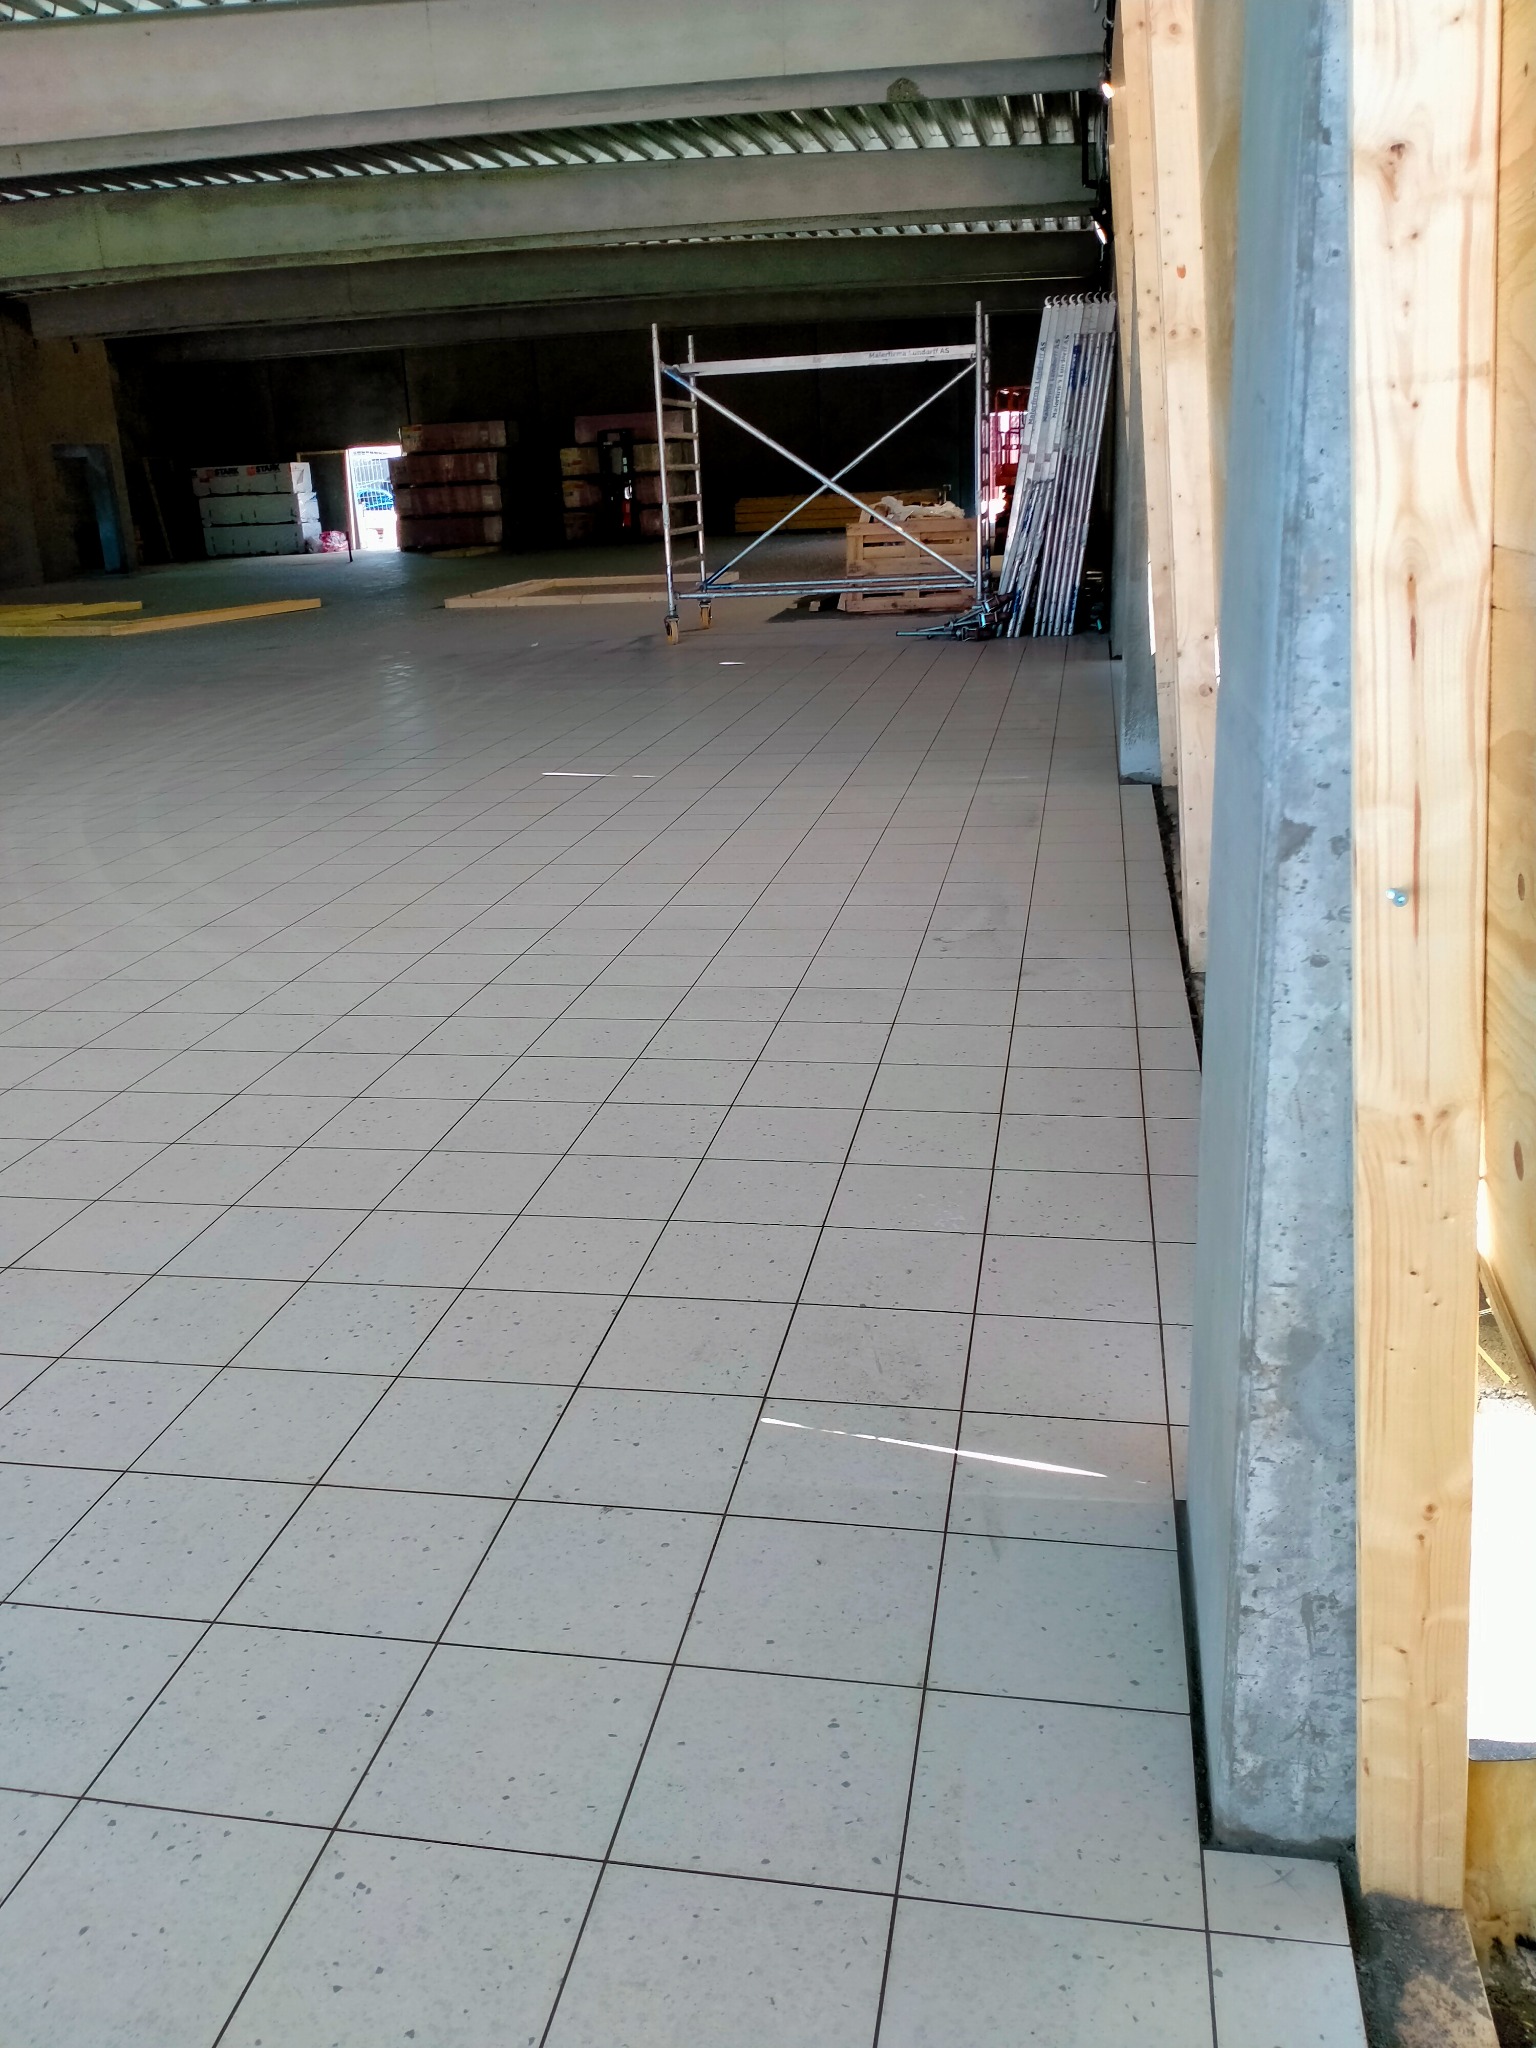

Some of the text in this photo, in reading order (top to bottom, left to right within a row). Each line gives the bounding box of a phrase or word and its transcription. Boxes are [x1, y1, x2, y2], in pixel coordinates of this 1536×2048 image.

[868, 351, 907, 359] Malerfirma
[215, 467, 239, 475] STARK
[256, 464, 280, 473] STARK
